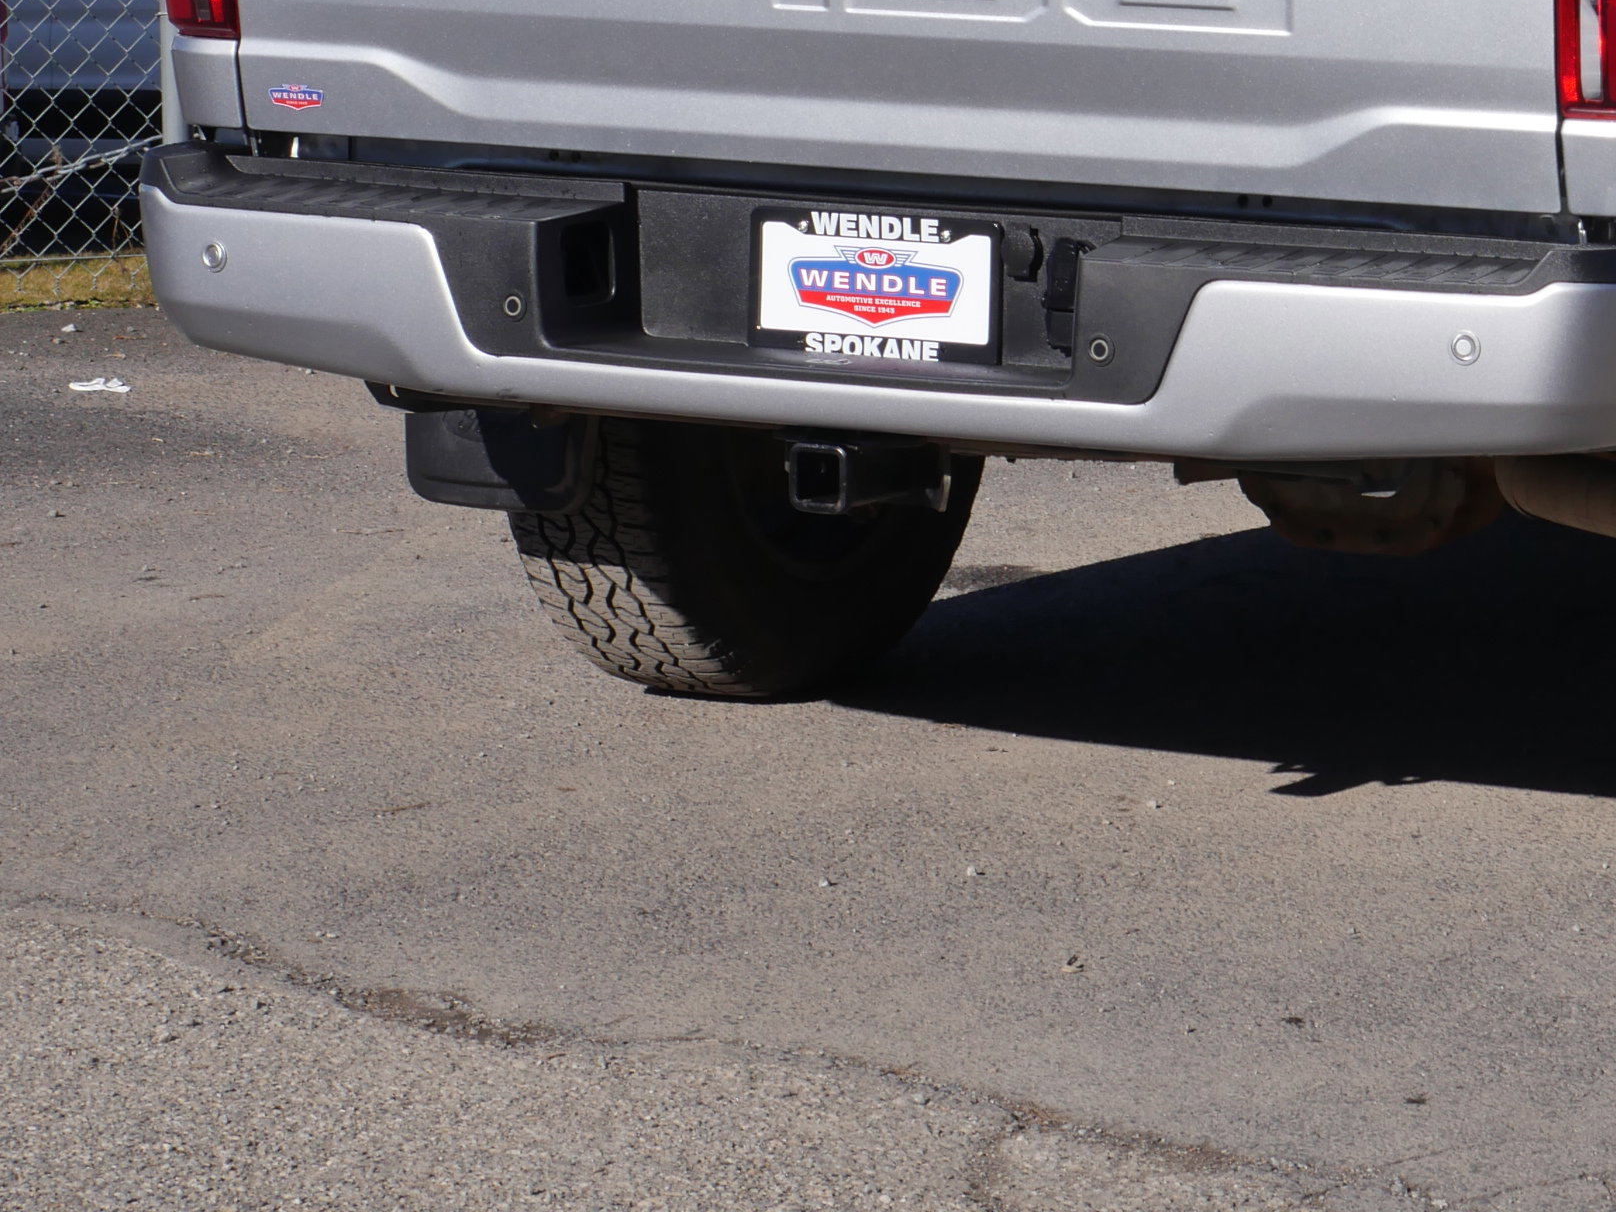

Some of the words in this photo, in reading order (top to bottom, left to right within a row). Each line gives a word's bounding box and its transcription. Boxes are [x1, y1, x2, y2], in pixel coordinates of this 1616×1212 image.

[272, 92, 318, 100] WENDLE
[811, 212, 939, 242] WENDLE
[801, 269, 947, 296] WENDLE
[825, 294, 873, 305] AUTOMOTIVE
[874, 298, 921, 308] EXCELLENCE
[853, 305, 876, 313] SINCE
[805, 333, 939, 361] SPOKANE
